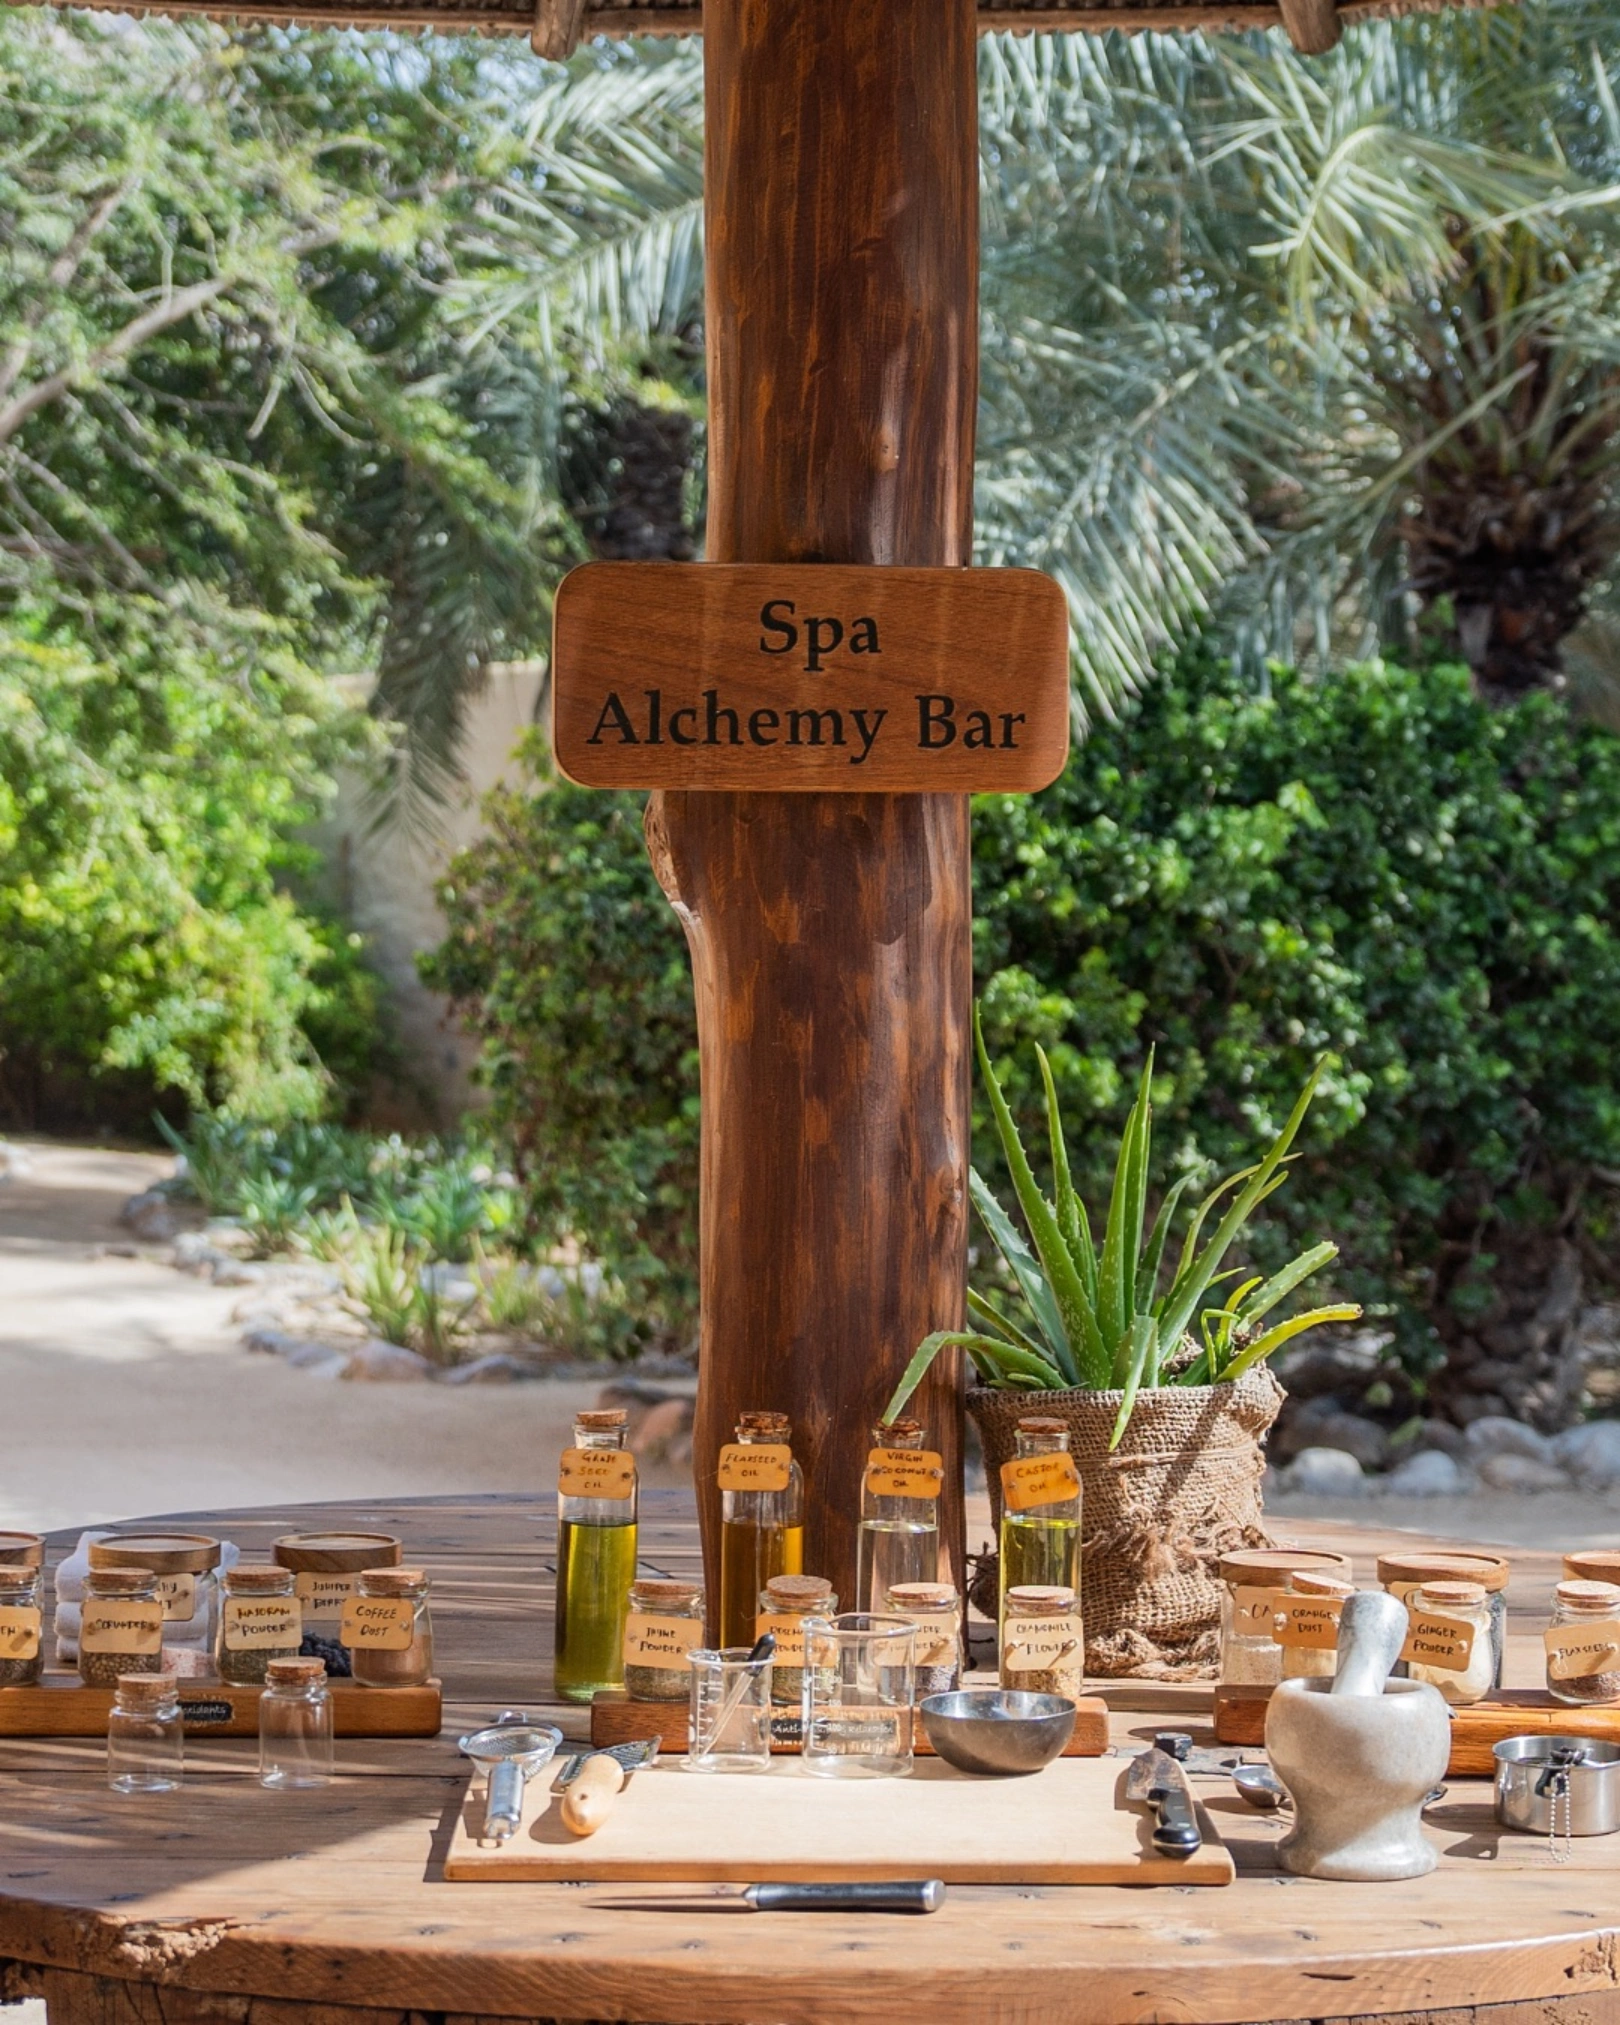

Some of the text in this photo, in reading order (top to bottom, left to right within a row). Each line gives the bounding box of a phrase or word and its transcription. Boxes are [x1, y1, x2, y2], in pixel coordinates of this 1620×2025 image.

[759, 599, 882, 672] Spa
[585, 690, 1026, 765] Alchemy Bar
[725, 1453, 778, 1464] FLAXSEED
[887, 1451, 923, 1462] VIRGIN
[881, 1465, 927, 1475] COCONUT
[1016, 1462, 1060, 1478] CASTOR
[356, 1605, 398, 1620] COFFEE
[1291, 1608, 1332, 1620] ORANGE
[360, 1624, 389, 1637] DUST
[1297, 1623, 1324, 1633] DUST
[1416, 1623, 1458, 1639] GINGER
[639, 1640, 683, 1654] POWDER
[1412, 1639, 1456, 1656] POWDER
